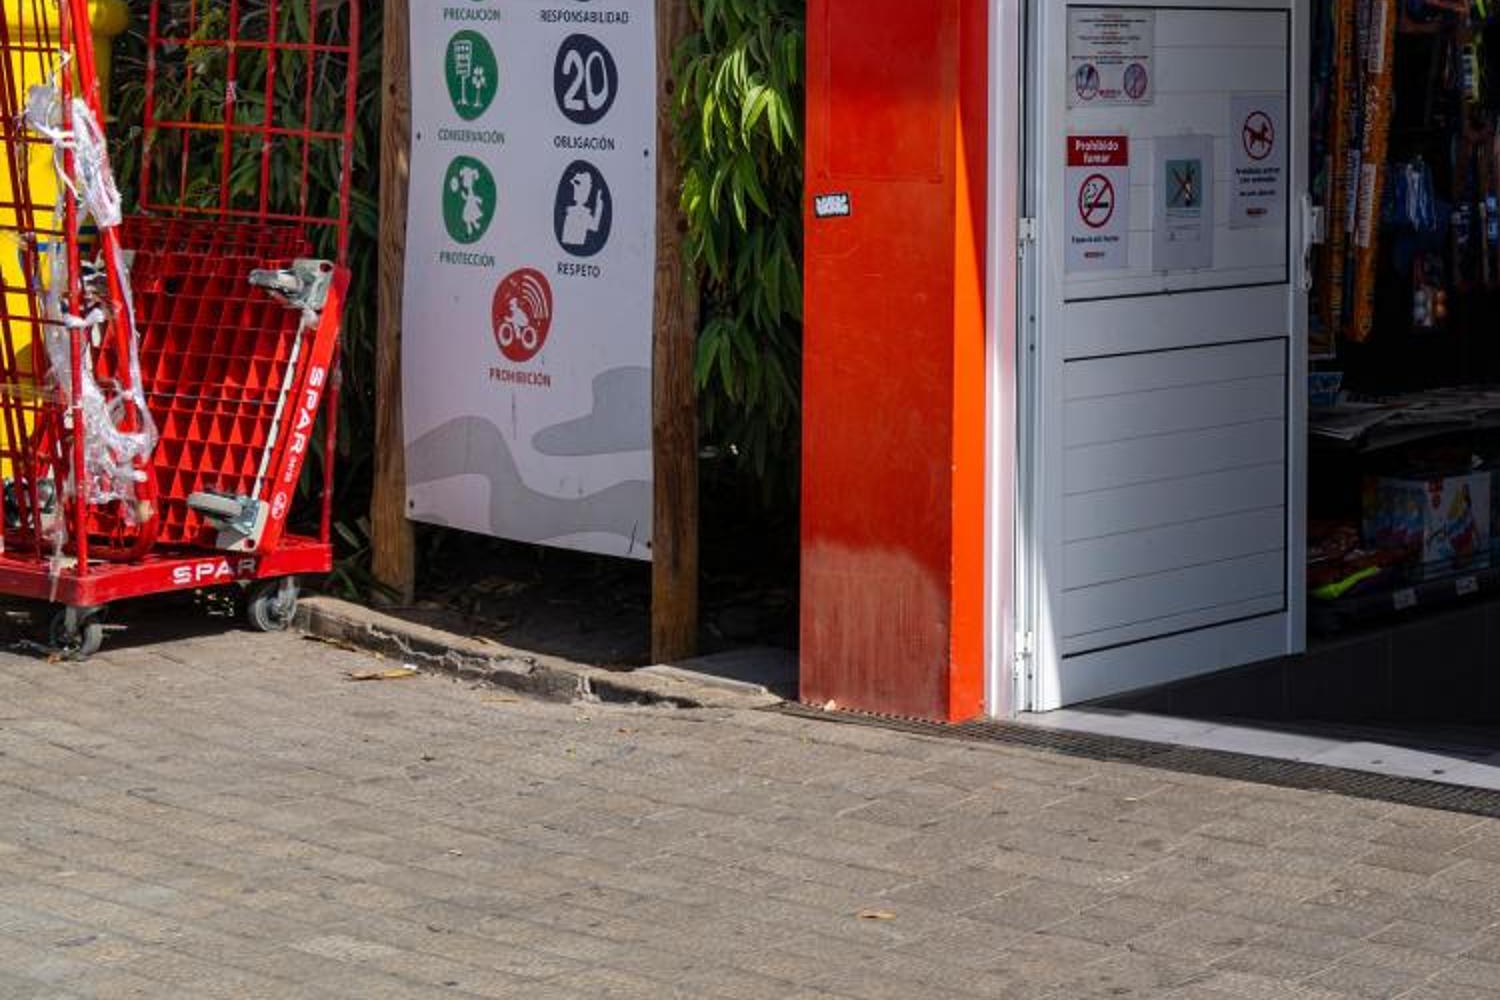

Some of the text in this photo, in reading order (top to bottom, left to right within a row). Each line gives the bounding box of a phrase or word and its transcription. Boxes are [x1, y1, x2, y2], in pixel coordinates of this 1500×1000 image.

[540, 9, 630, 25] RESPONSABILIDAD
[562, 50, 609, 111] 20
[557, 261, 601, 278] RESPETO
[289, 366, 325, 454] SPAR
[172, 557, 257, 584] SPAR
